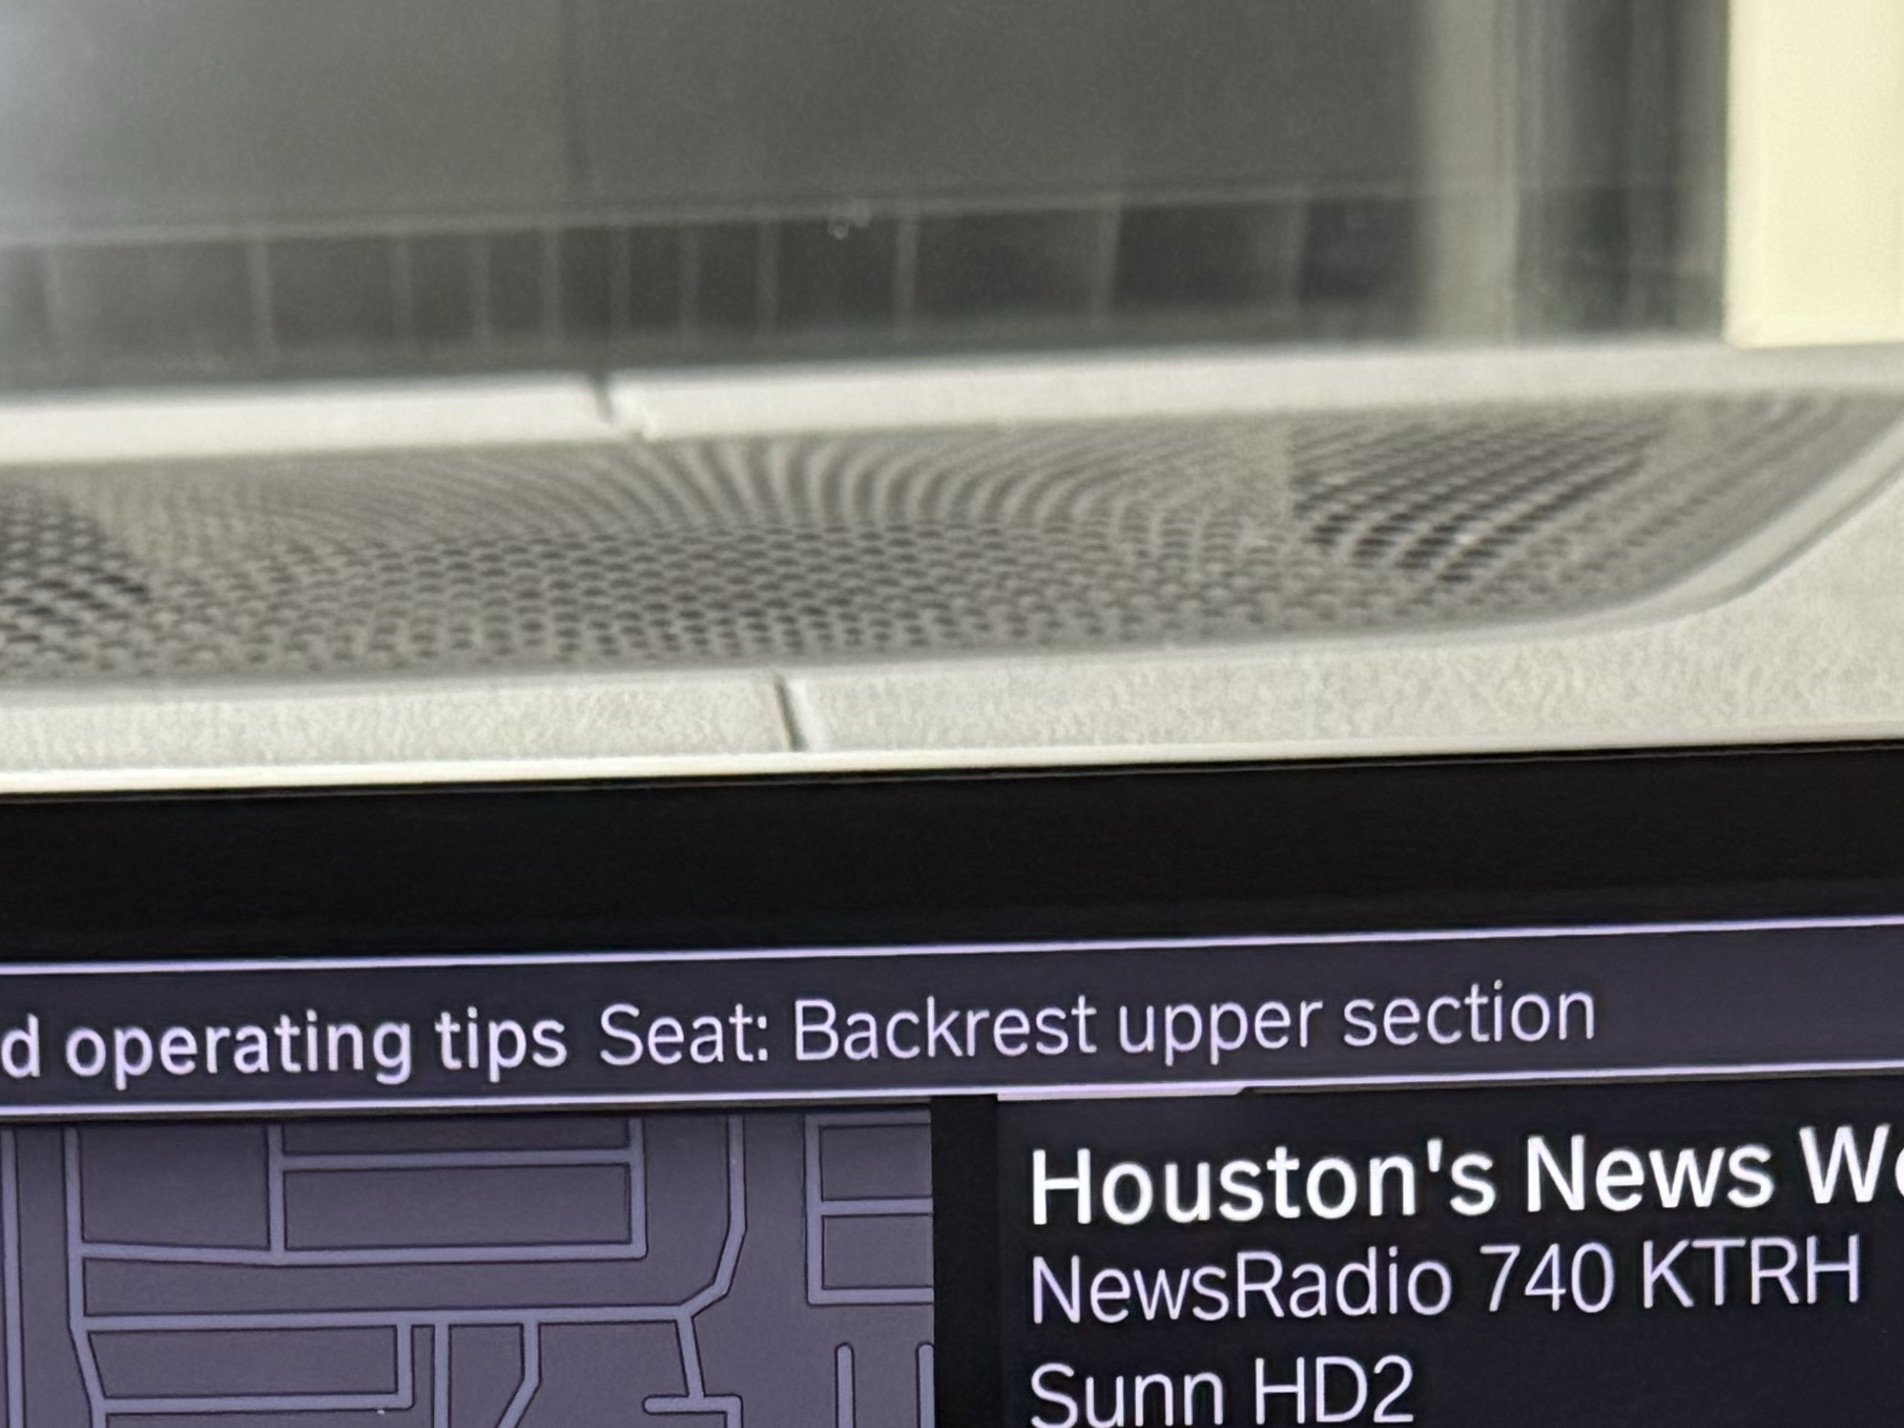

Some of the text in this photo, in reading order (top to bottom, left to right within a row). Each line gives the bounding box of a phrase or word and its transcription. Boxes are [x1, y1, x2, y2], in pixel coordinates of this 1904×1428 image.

[66, 1010, 411, 1090] operating
[435, 1007, 567, 1082] tips
[601, 1004, 767, 1065] Seat:
[796, 996, 1096, 1060] Backrest
[1119, 998, 1323, 1067] upper
[1341, 980, 1595, 1054] section
[1033, 1139, 1495, 1225] Houston's
[1528, 1135, 1774, 1212] News
[1033, 1235, 1858, 1323] NewsRadio 740 KTRH
[1256, 1355, 1413, 1424] HD2
